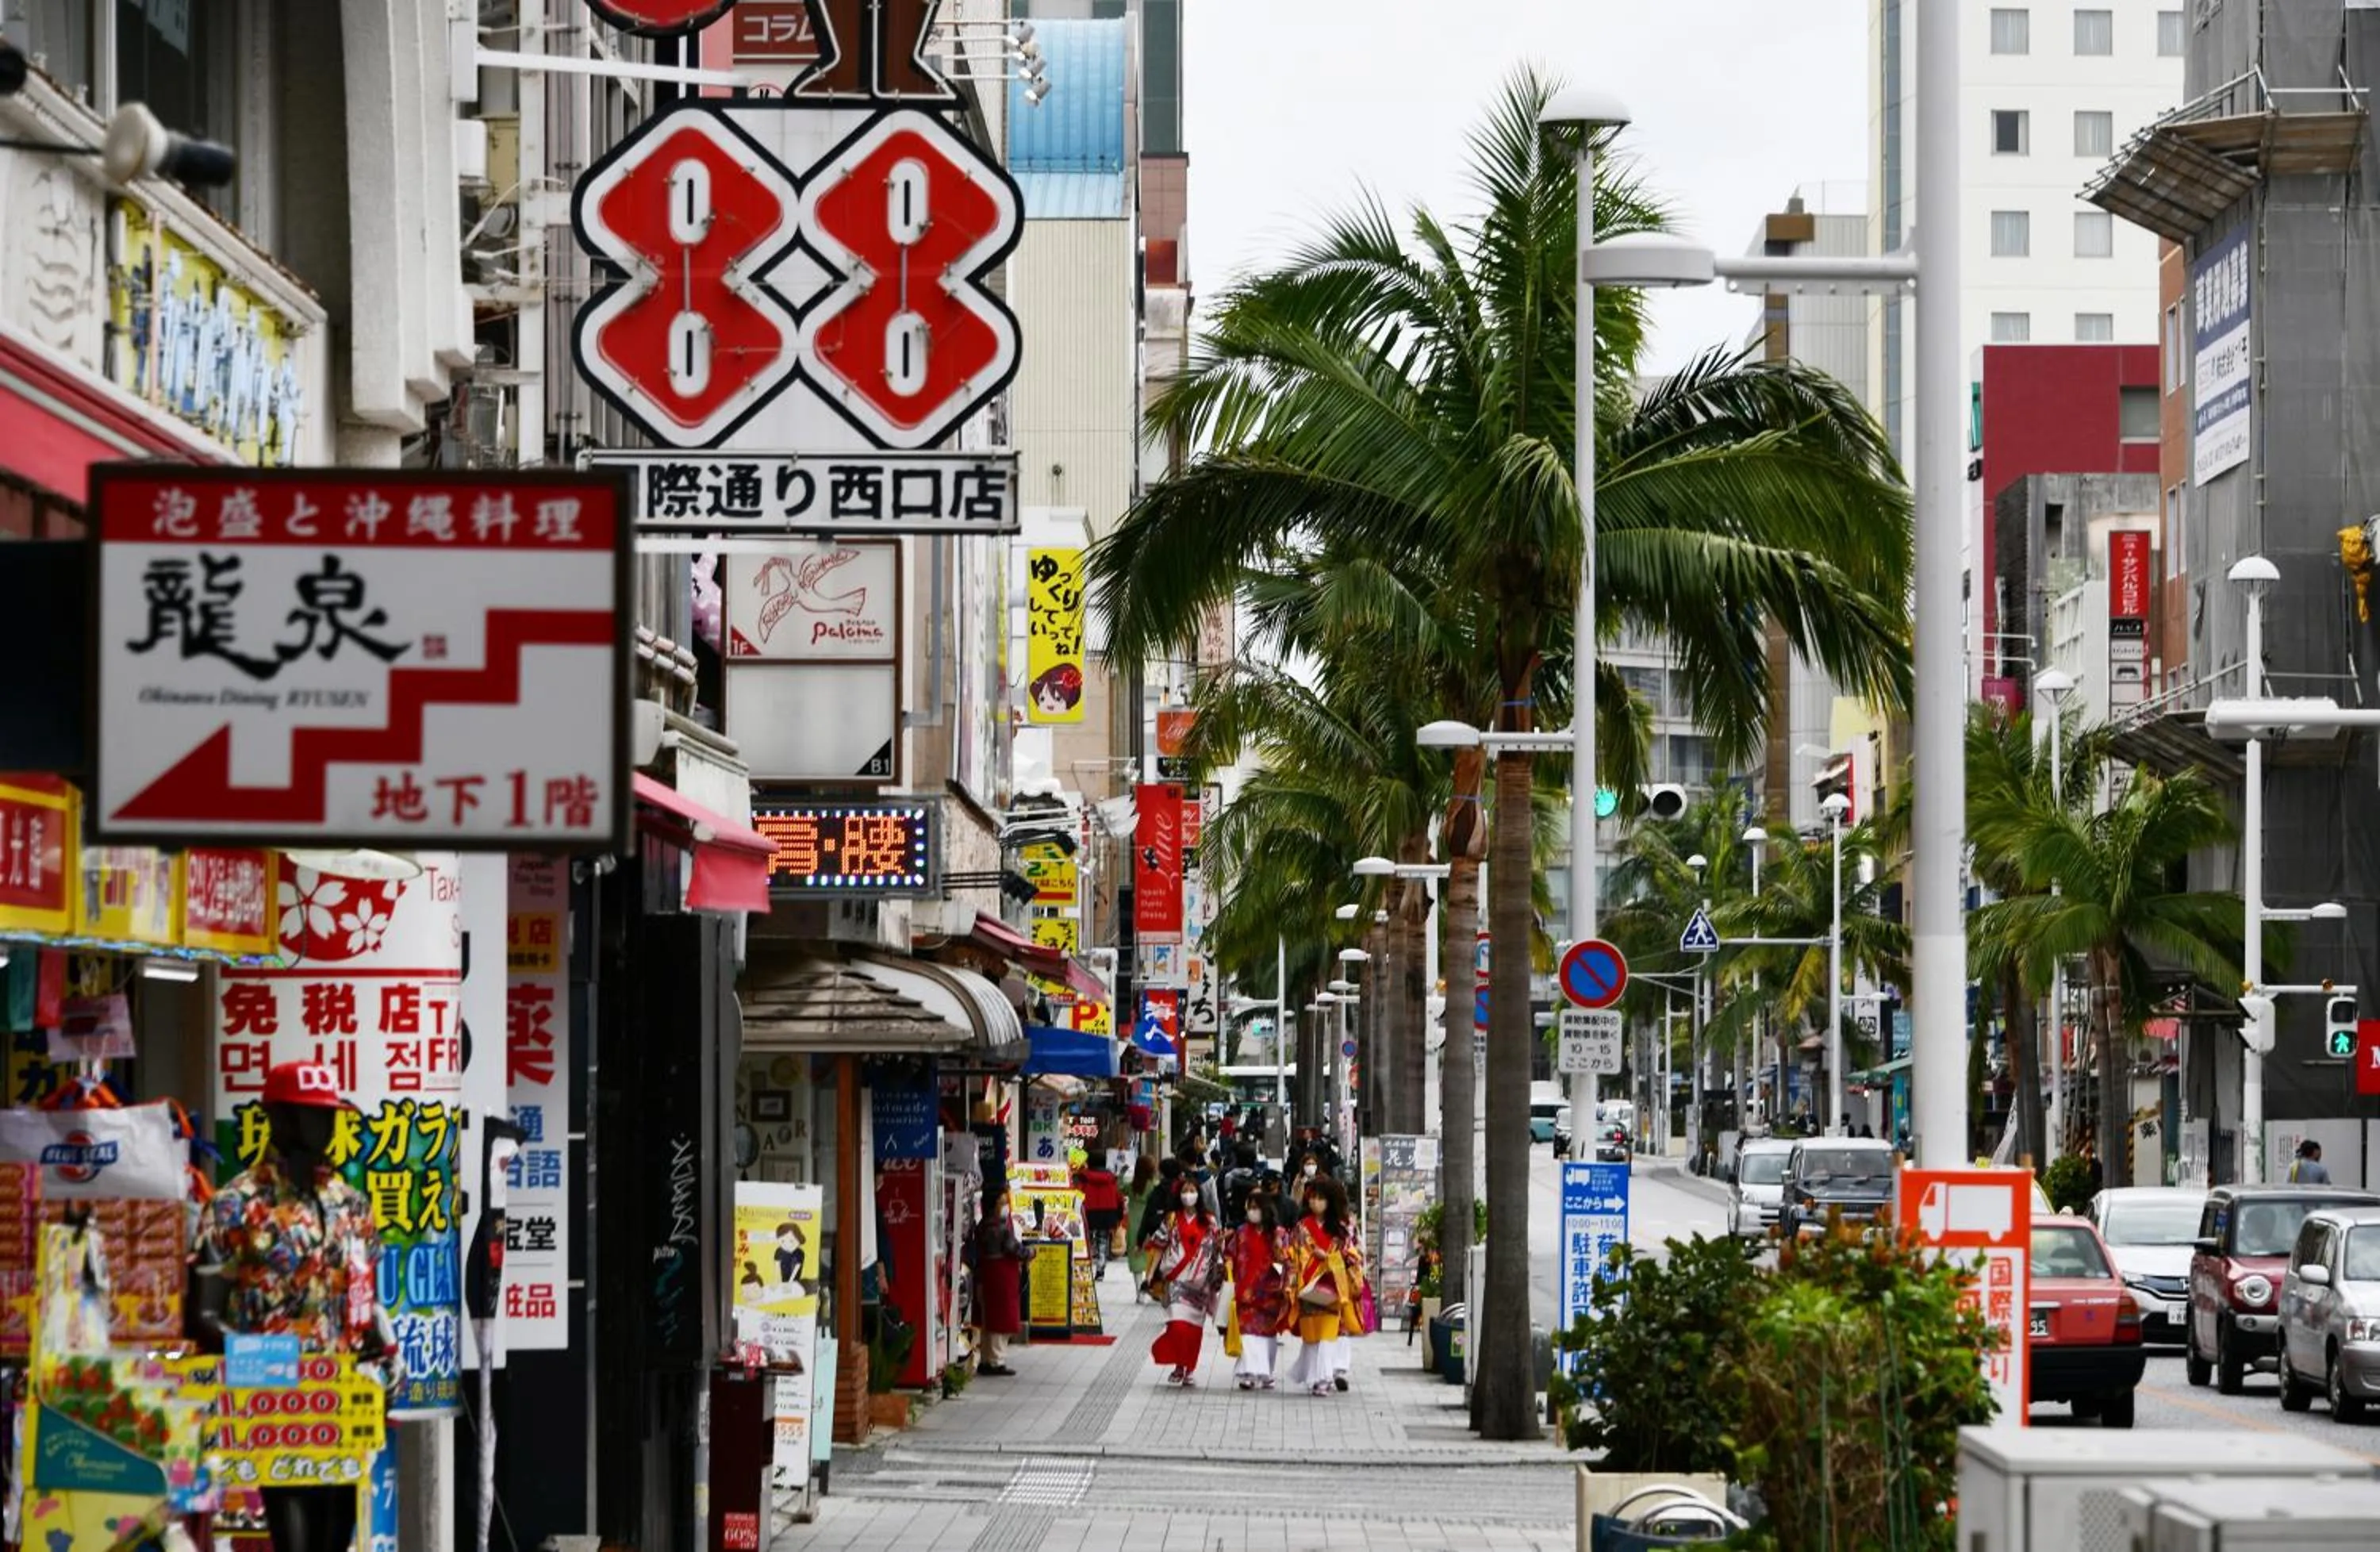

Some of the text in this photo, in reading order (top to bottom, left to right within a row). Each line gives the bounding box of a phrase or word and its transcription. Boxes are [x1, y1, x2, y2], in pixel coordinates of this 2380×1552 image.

[647, 463, 1006, 520] 際通り西口店
[152, 486, 583, 543] 泡盛と沖縄料理
[125, 551, 413, 680] 龍泉
[218, 687, 278, 710] Dining
[870, 759, 889, 773] B1
[370, 769, 599, 829] 地下1階
[221, 982, 421, 1035] 免税店
[1072, 1001, 1099, 1030] P
[428, 1038, 459, 1072] FR
[1565, 1056, 1614, 1070] ここから
[1564, 1194, 1603, 1209] ここから
[405, 1244, 459, 1305] GLA
